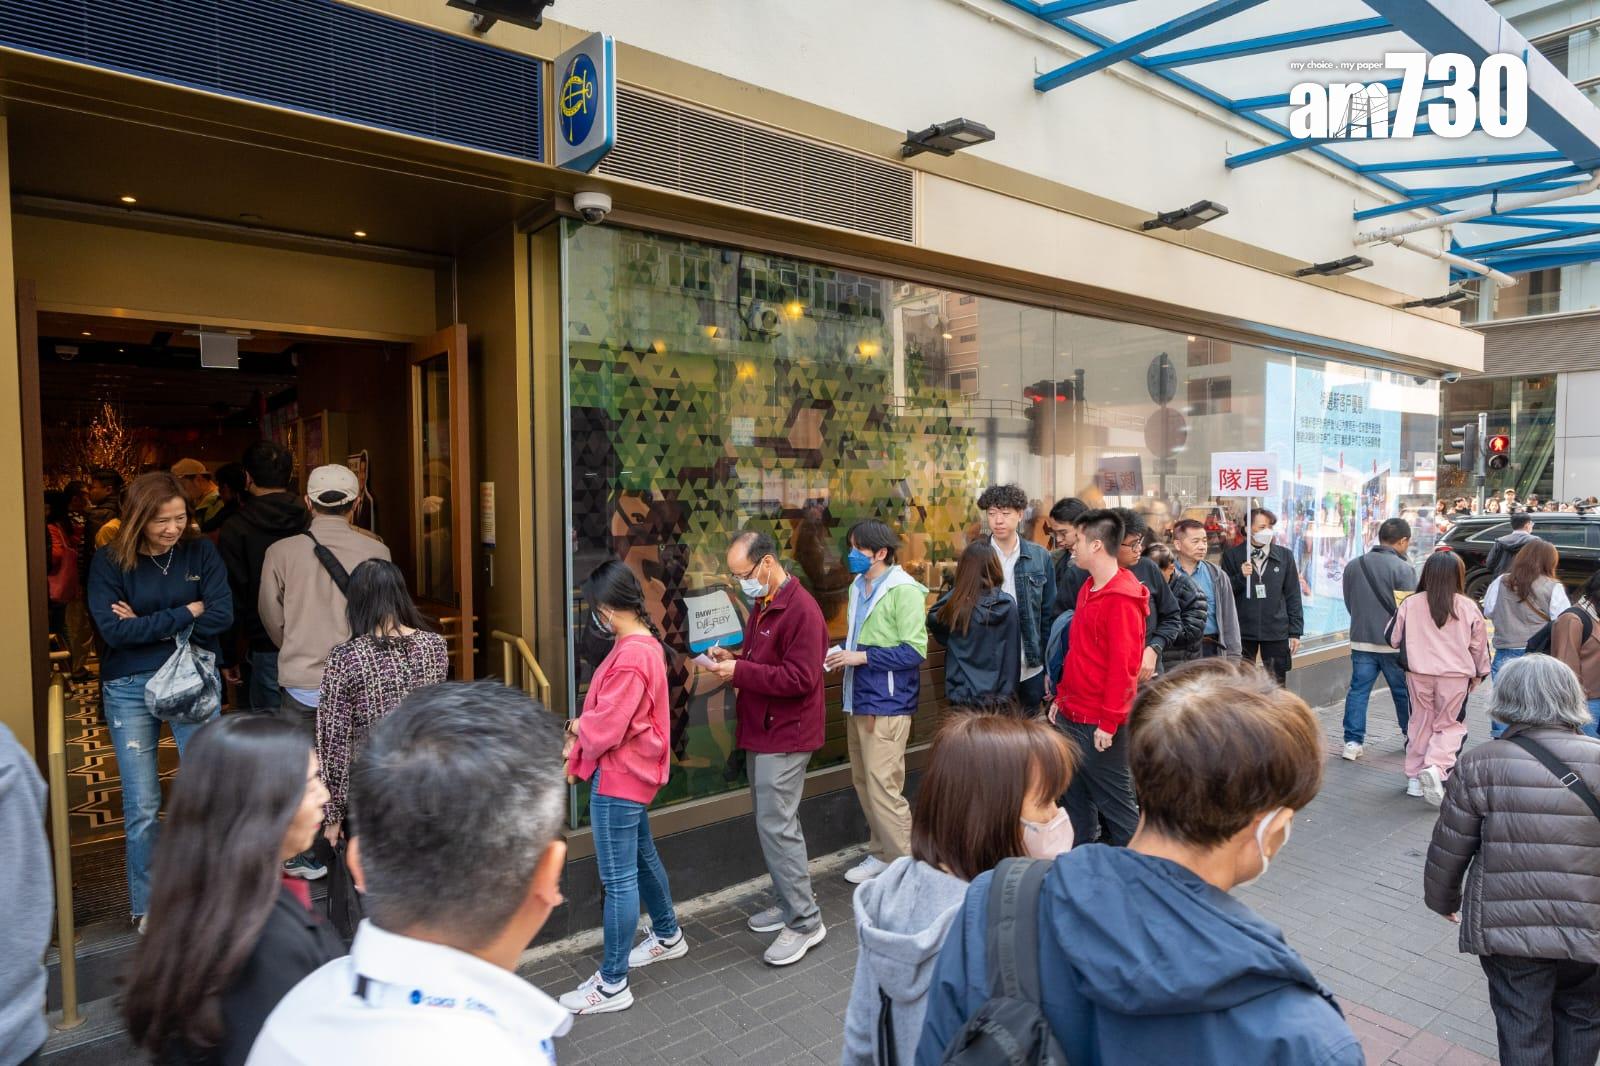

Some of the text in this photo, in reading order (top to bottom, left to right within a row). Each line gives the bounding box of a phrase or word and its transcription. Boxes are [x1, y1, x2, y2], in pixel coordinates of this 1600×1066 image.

[1219, 468, 1269, 491] 隊尾
[695, 609, 712, 619] BMW
[585, 992, 602, 1006] N
